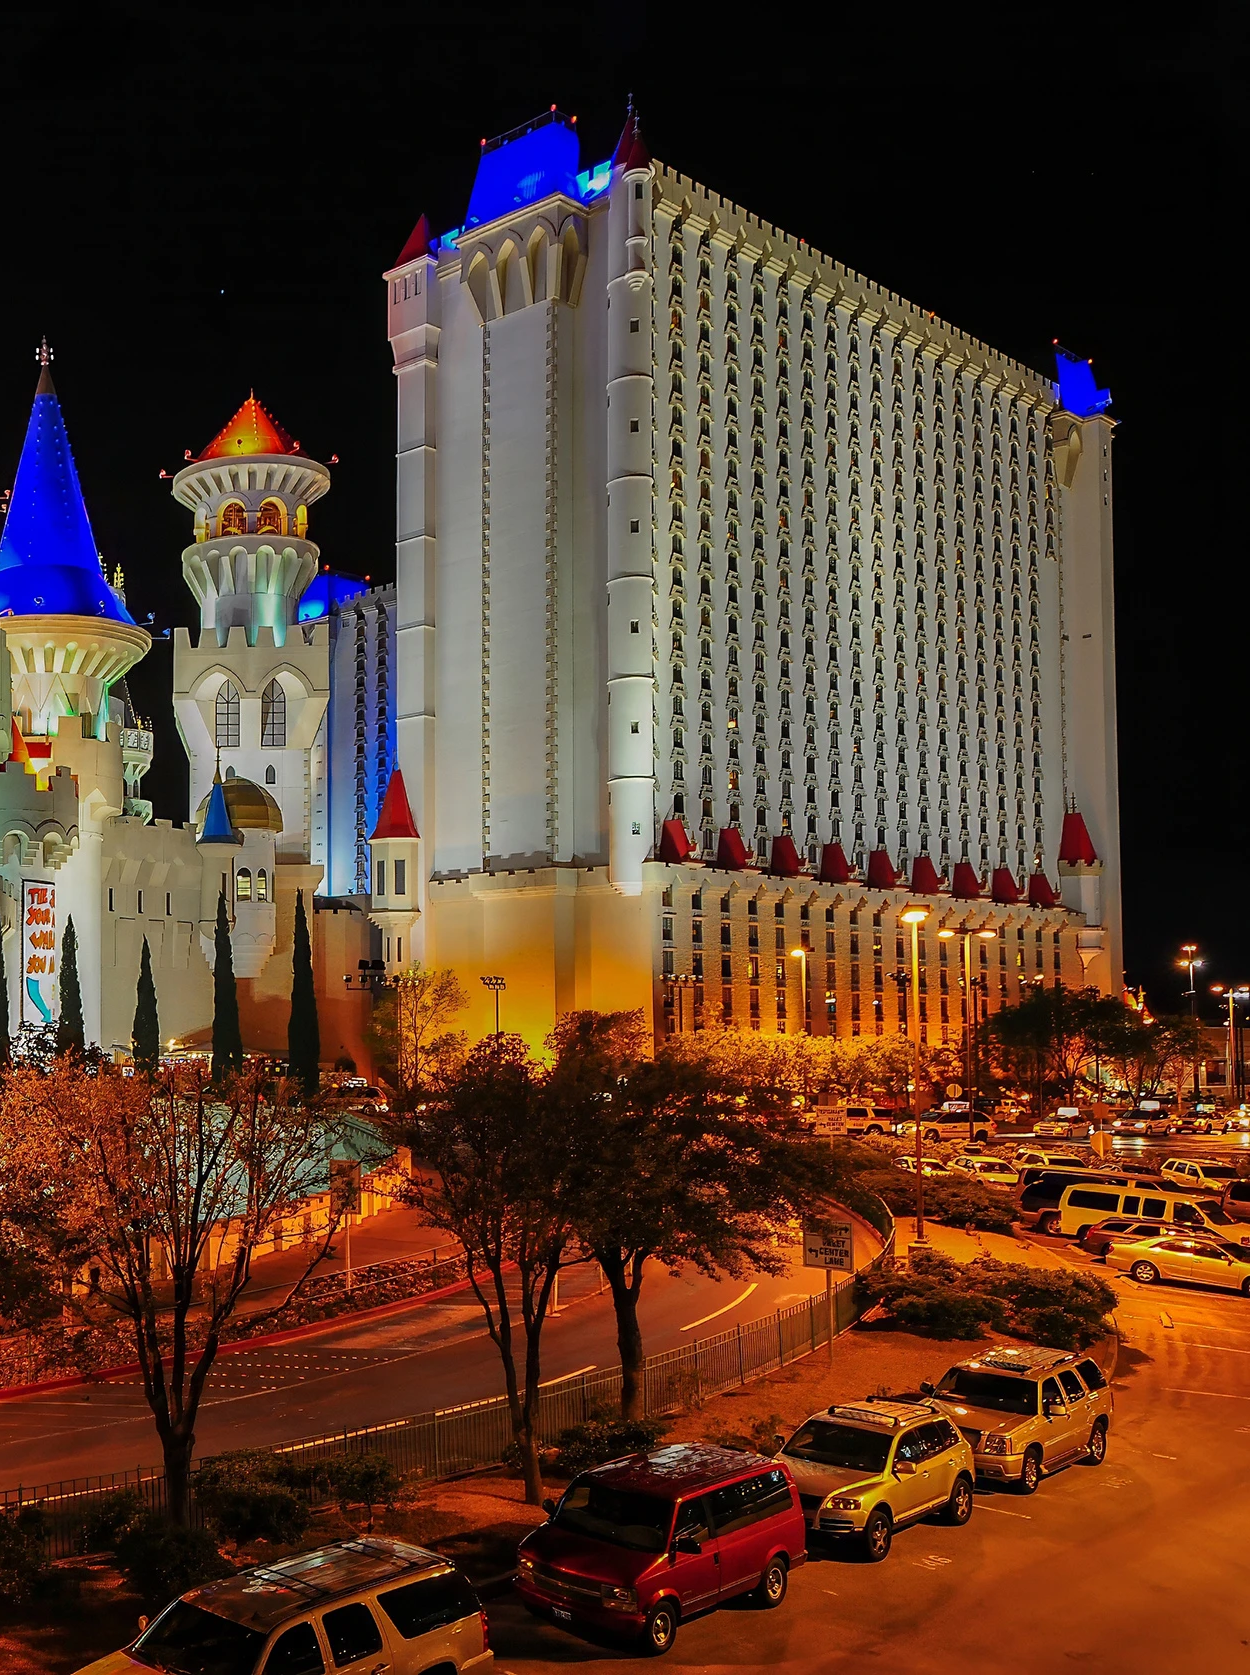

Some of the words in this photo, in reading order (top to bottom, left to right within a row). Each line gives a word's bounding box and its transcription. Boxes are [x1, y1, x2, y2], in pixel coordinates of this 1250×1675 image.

[28, 887, 48, 904] THE
[819, 1247, 849, 1258] CENTER
[824, 1257, 844, 1266] LANE
